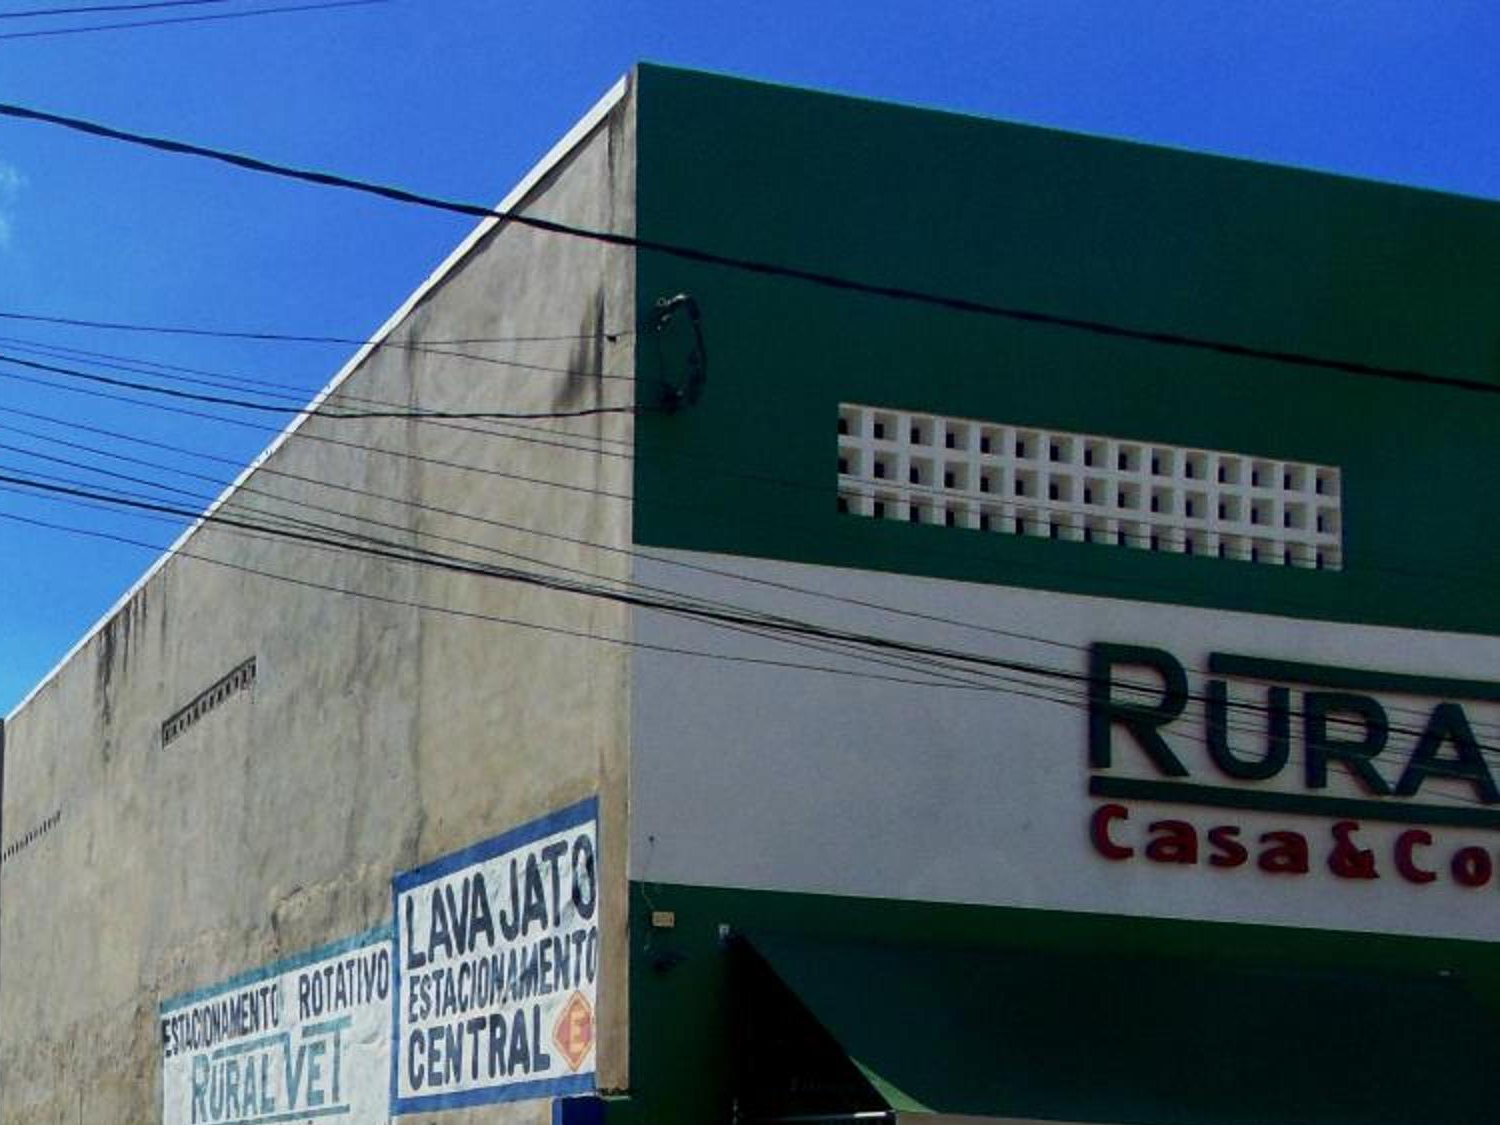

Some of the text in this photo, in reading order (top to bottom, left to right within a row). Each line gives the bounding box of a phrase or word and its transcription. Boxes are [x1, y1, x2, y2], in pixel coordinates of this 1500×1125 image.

[405, 833, 597, 970] LAVA JATO
[160, 948, 390, 1058] ESTACIONAMENTO ROTATIVO
[407, 925, 598, 1024] ESTACIONAMENTO
[408, 1004, 551, 1091] CENTRAL
